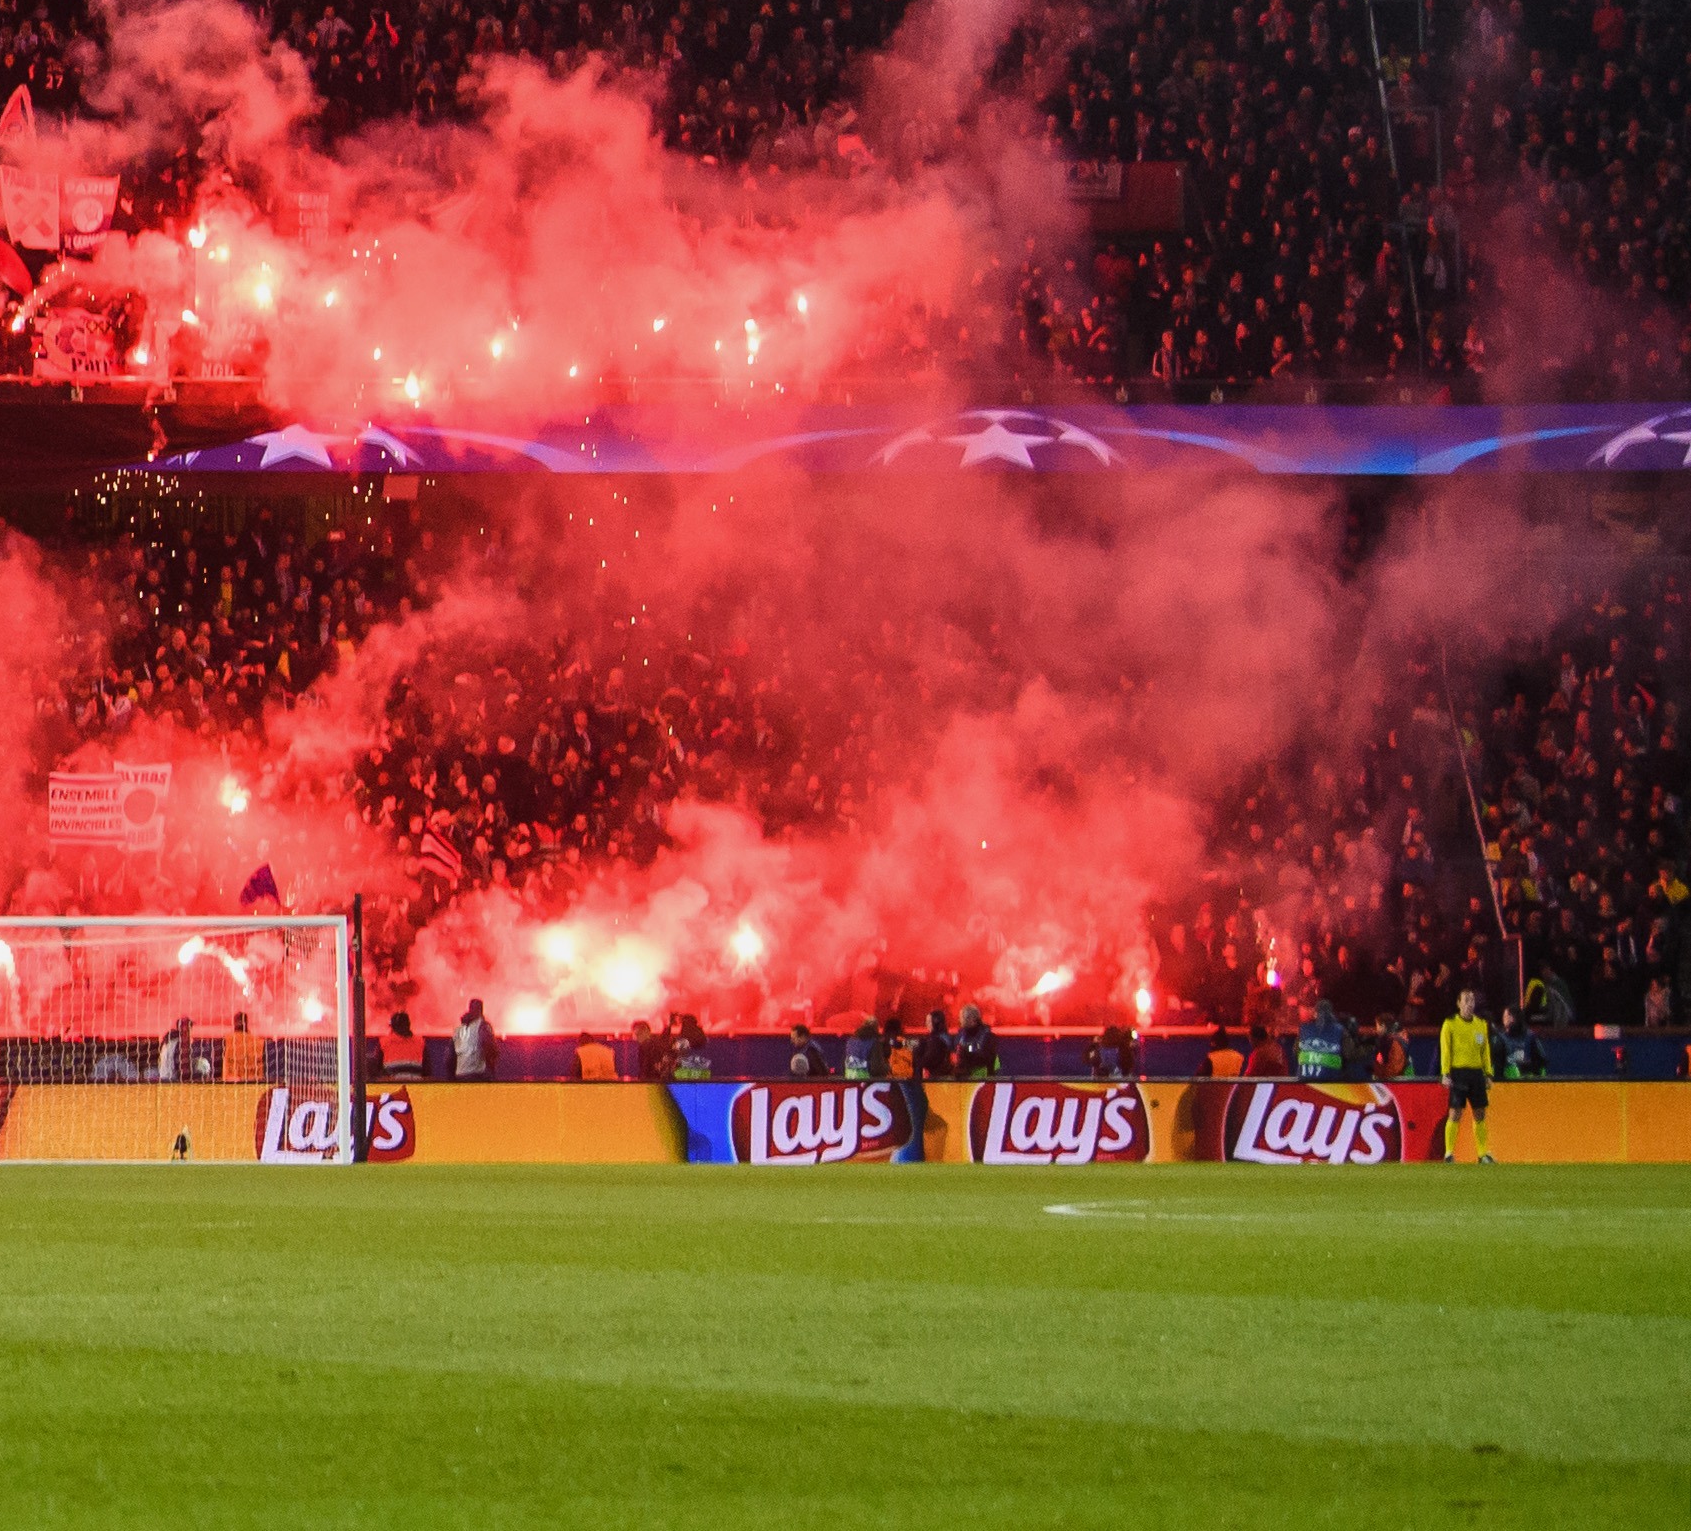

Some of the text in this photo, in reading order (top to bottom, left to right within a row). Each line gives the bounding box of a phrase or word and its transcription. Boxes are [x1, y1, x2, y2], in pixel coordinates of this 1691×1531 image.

[50, 789, 117, 802] ENSEMBLE
[50, 818, 123, 832] INVINCIBLES
[750, 1082, 893, 1166] Lay's
[981, 1083, 1136, 1165] Lay's
[1233, 1083, 1393, 1165] Lay's
